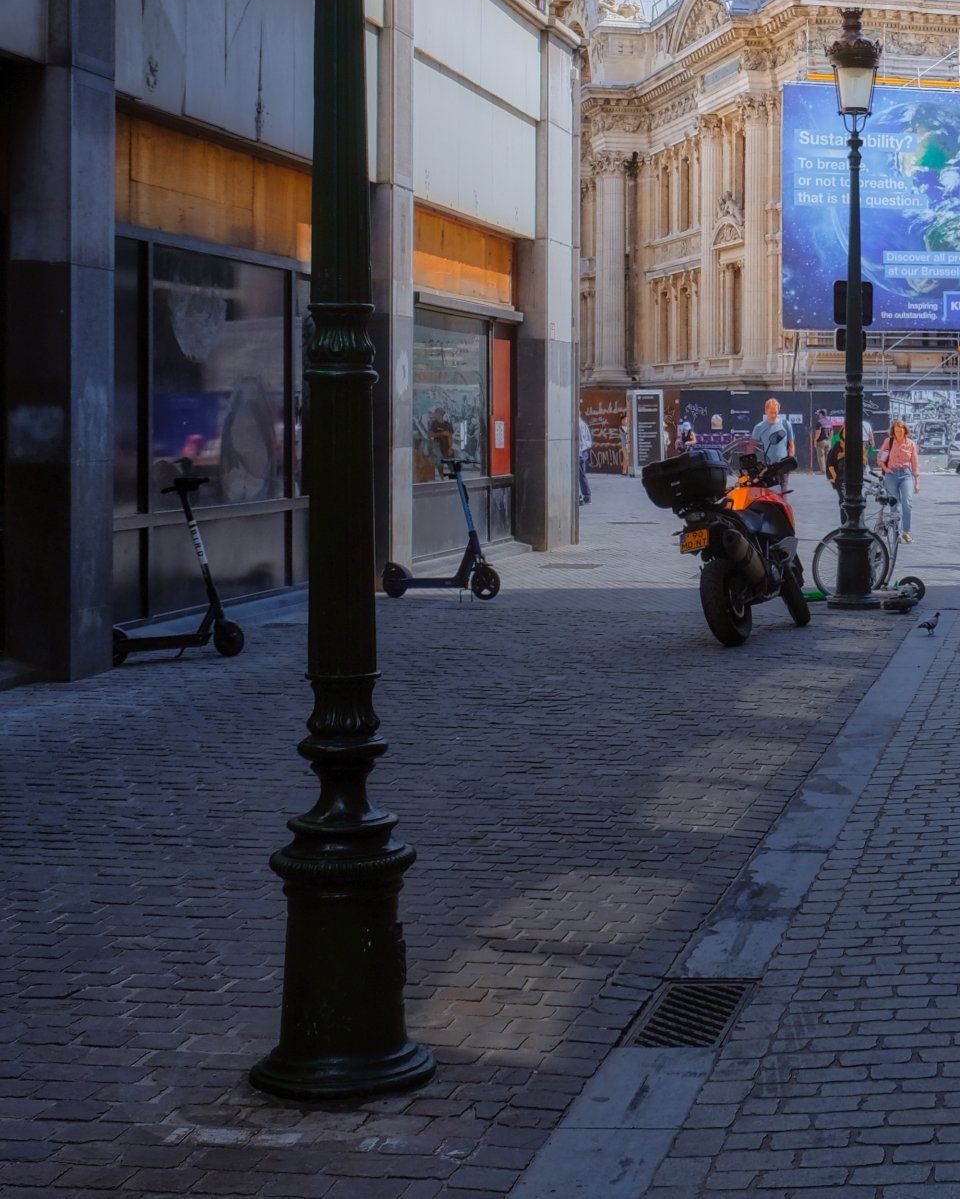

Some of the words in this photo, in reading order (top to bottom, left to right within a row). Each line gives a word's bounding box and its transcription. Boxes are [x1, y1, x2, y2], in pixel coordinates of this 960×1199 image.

[799, 131, 912, 151] Sustaibility?
[798, 158, 813, 168] To
[817, 159, 869, 172] breae,
[798, 178, 811, 186] or
[815, 176, 836, 187] not
[798, 191, 823, 203] that
[827, 192, 838, 204] is
[865, 194, 923, 207] question.
[886, 252, 930, 262] Discover
[933, 253, 945, 262] all
[888, 267, 898, 276] at
[901, 267, 918, 276] our
[907, 301, 938, 311] Inspiring
[881, 311, 893, 319] the
